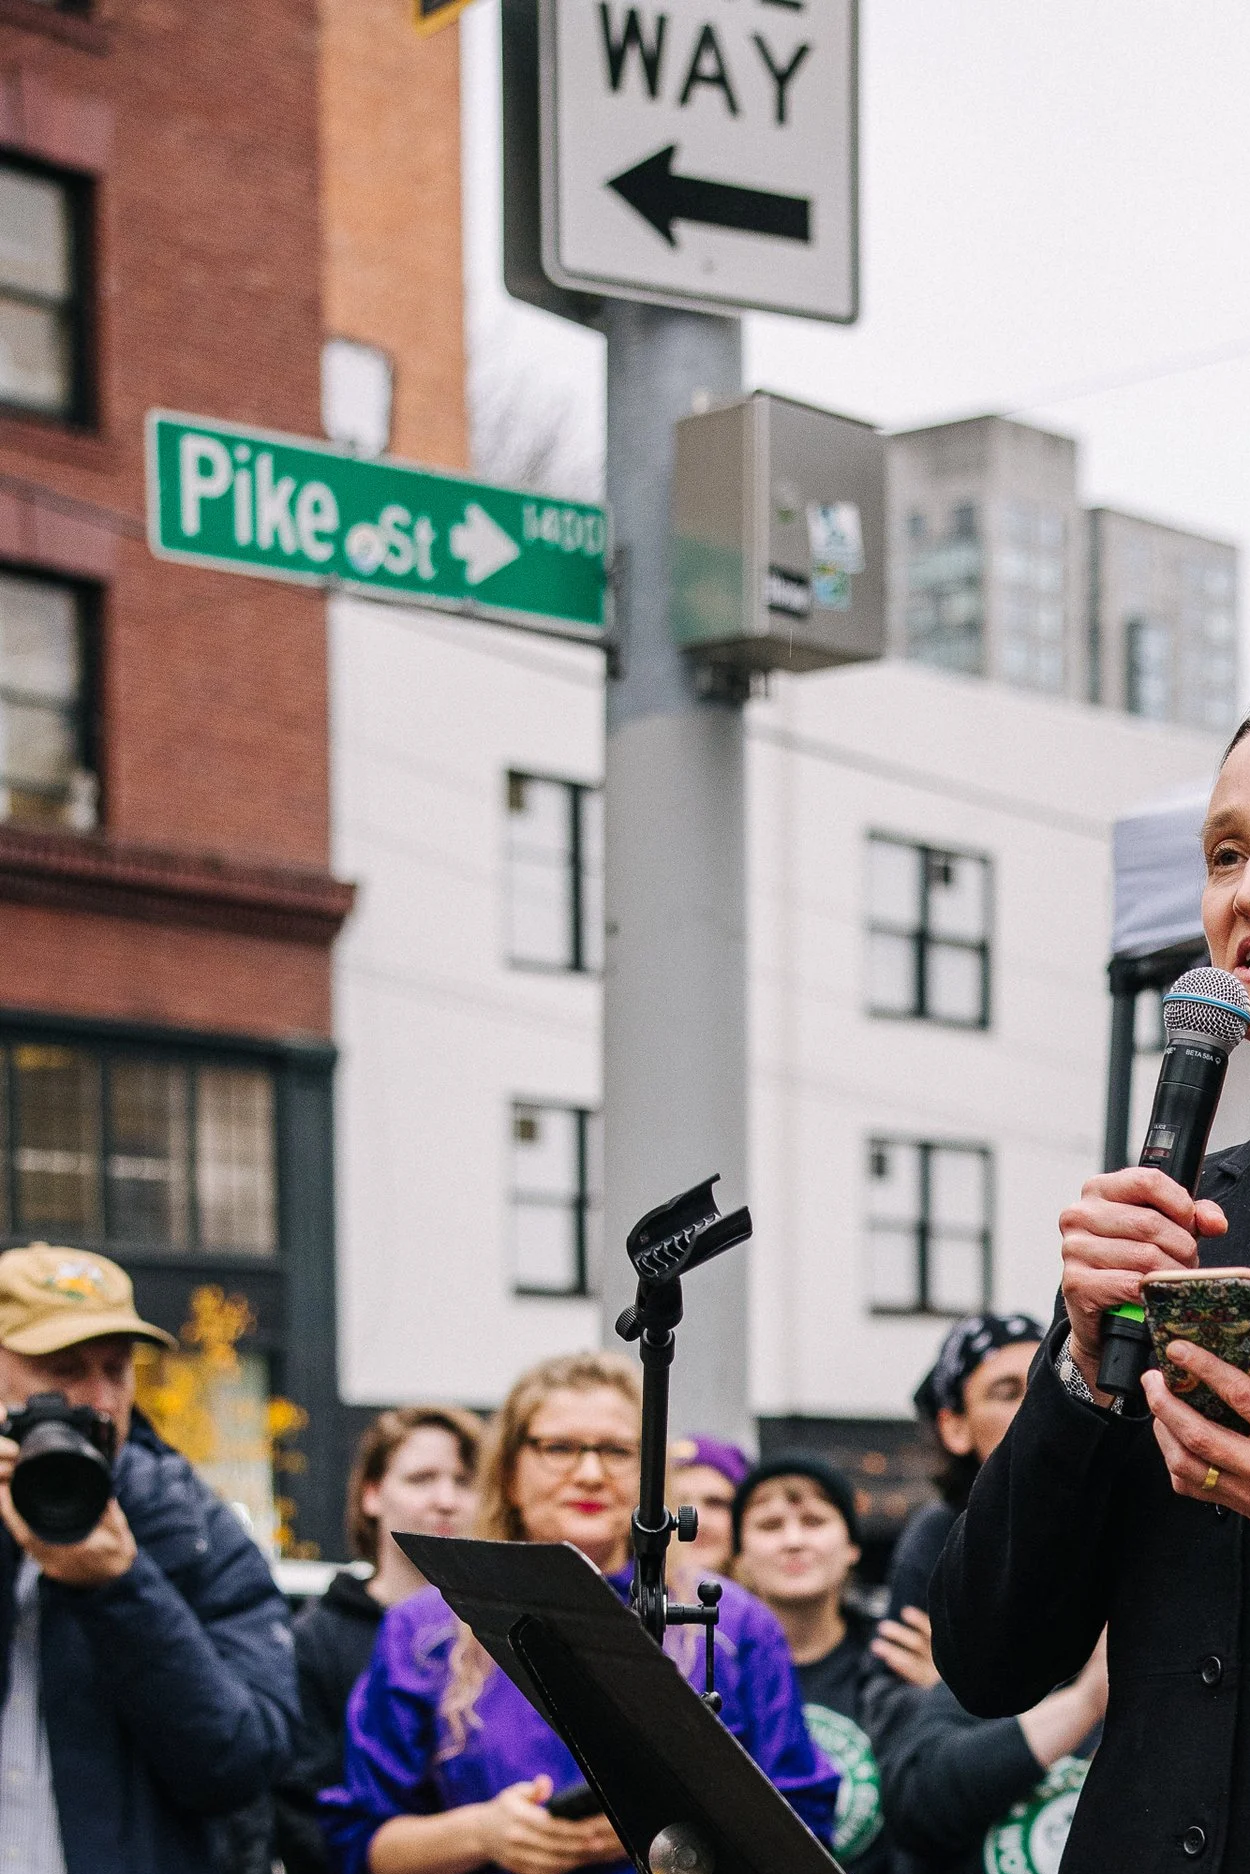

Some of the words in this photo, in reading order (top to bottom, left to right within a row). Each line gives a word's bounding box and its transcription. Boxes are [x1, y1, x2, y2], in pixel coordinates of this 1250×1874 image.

[599, 0, 811, 126] WAY
[180, 433, 340, 562] Pike
[379, 504, 436, 581] St
[1186, 1048, 1202, 1058] BETA
